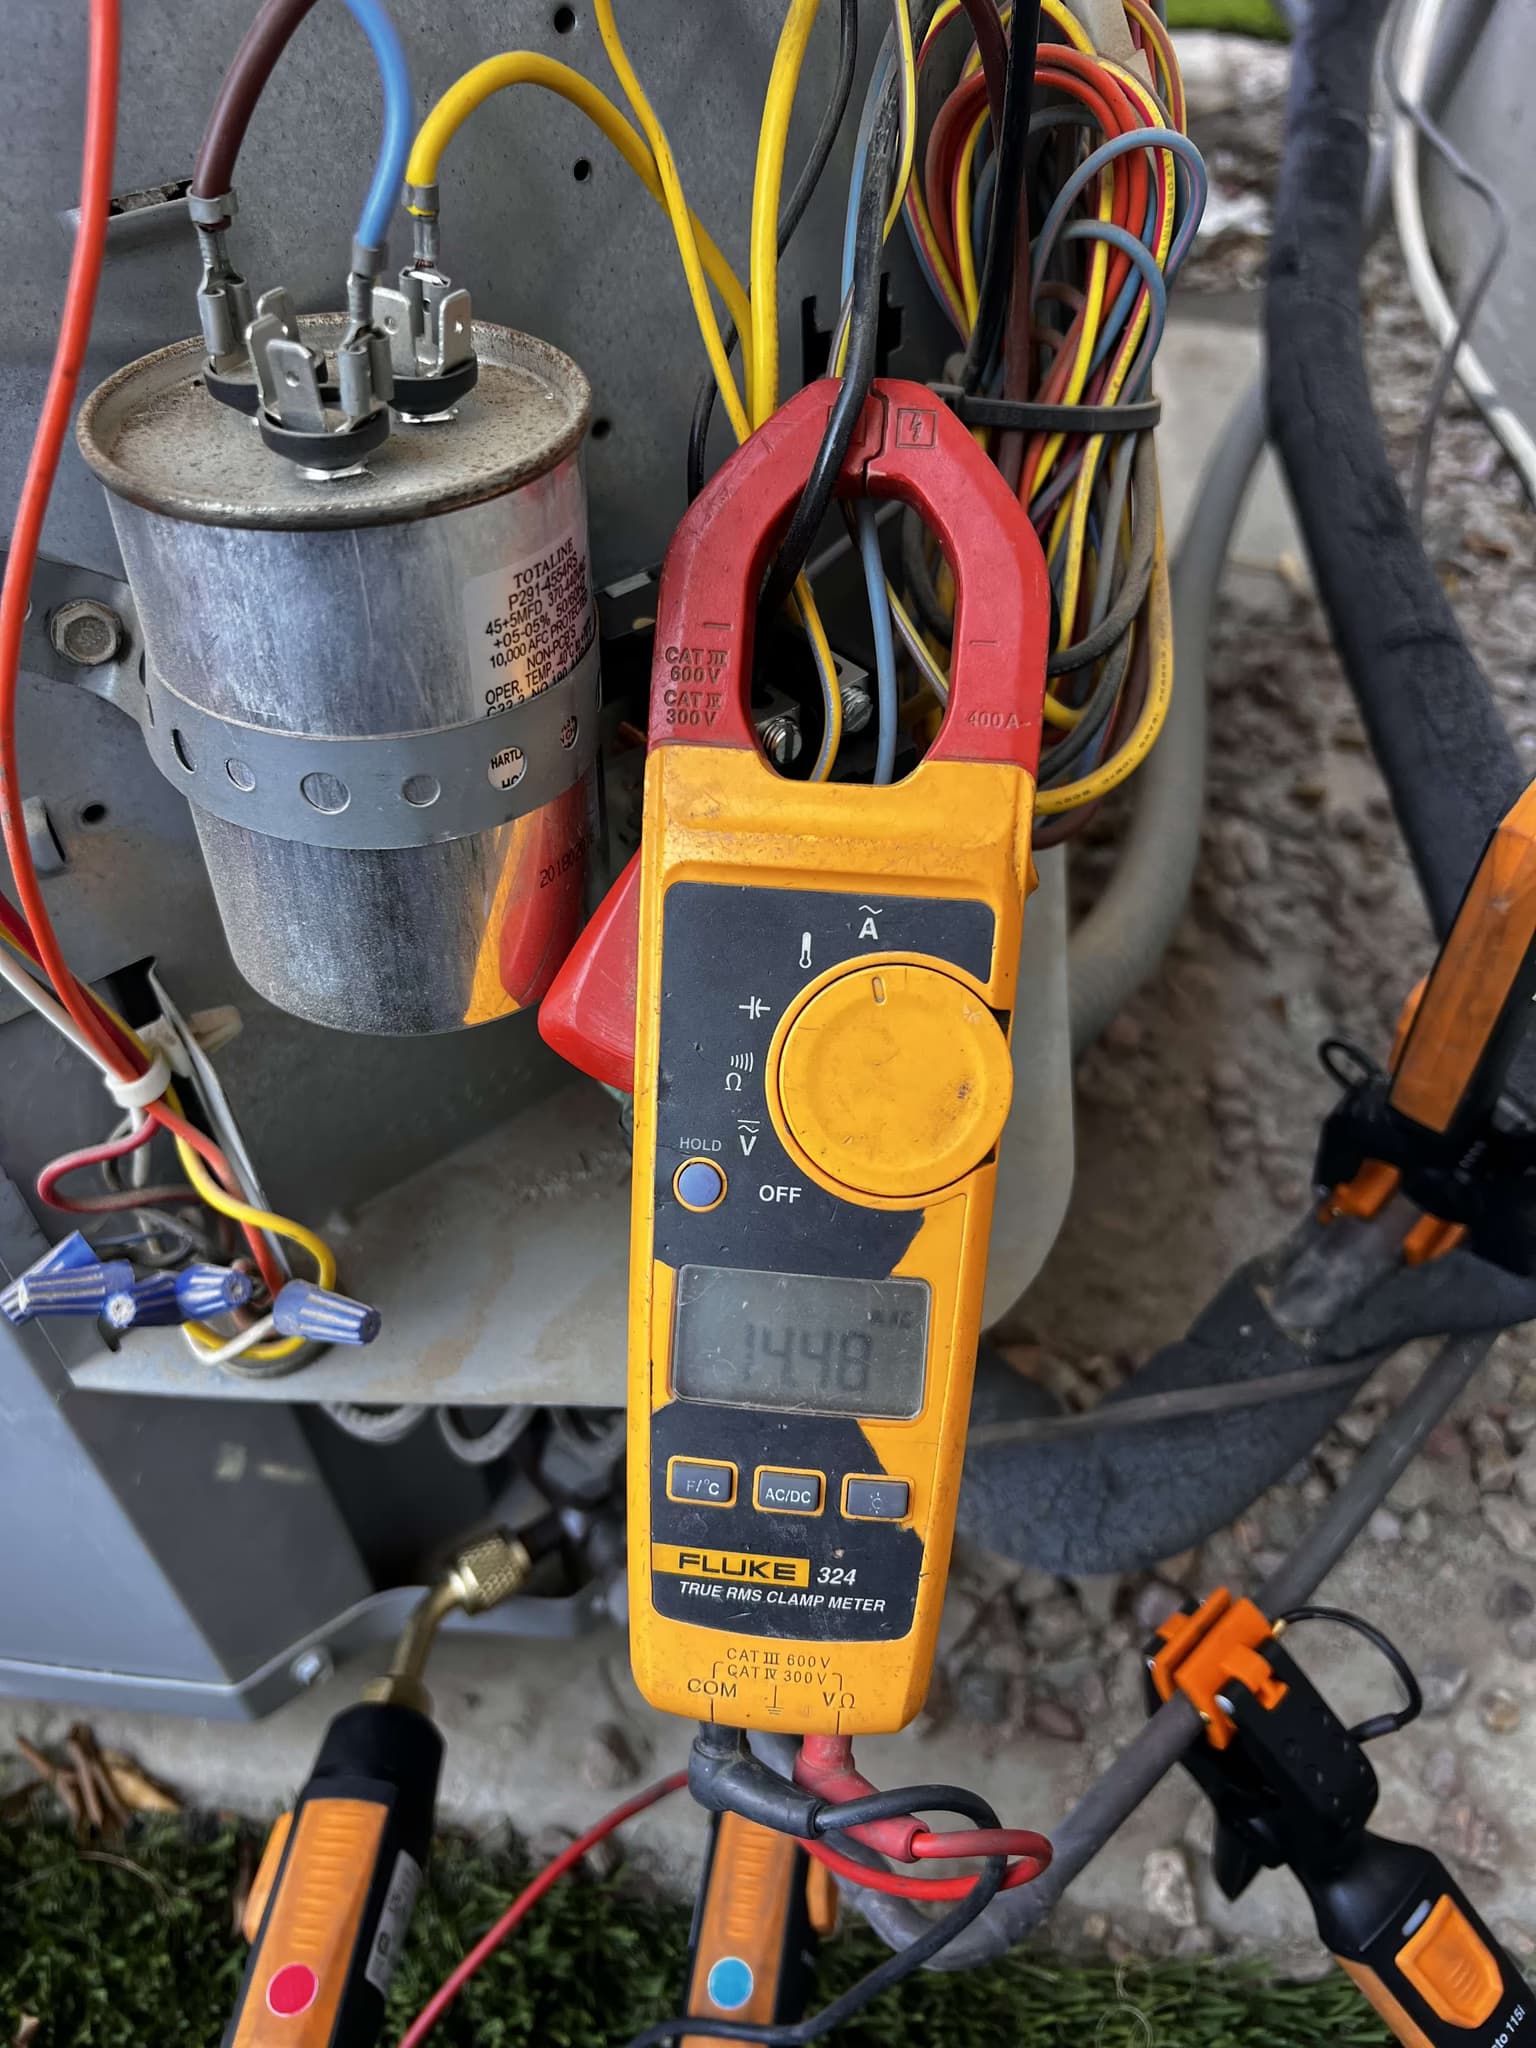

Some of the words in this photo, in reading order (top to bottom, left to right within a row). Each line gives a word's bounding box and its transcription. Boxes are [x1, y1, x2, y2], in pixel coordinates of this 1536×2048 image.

[513, 537, 574, 589] TOTALINE
[485, 601, 542, 636] 45+5MFD
[493, 613, 551, 650] +05-05%
[489, 643, 526, 668] 10,000
[528, 628, 549, 654] AFC
[527, 623, 577, 671] NON-PCB'S
[665, 646, 704, 665] CAT
[485, 680, 523, 705] OPER.
[525, 664, 555, 692] TEMP.
[664, 690, 703, 708] CAT
[680, 1136, 722, 1152] HOLD
[759, 1185, 802, 1204] OFF
[765, 1486, 812, 1504] AC/DC
[678, 1553, 796, 1582] FLUKE
[816, 1566, 858, 1587] 324
[679, 1581, 724, 1598] TRUE
[726, 1586, 762, 1602] RMS
[766, 1591, 825, 1608] CLAMP
[828, 1596, 886, 1613] METER
[726, 1647, 760, 1663] CAT
[727, 1664, 760, 1679] CAT
[687, 1678, 737, 1698] COM
